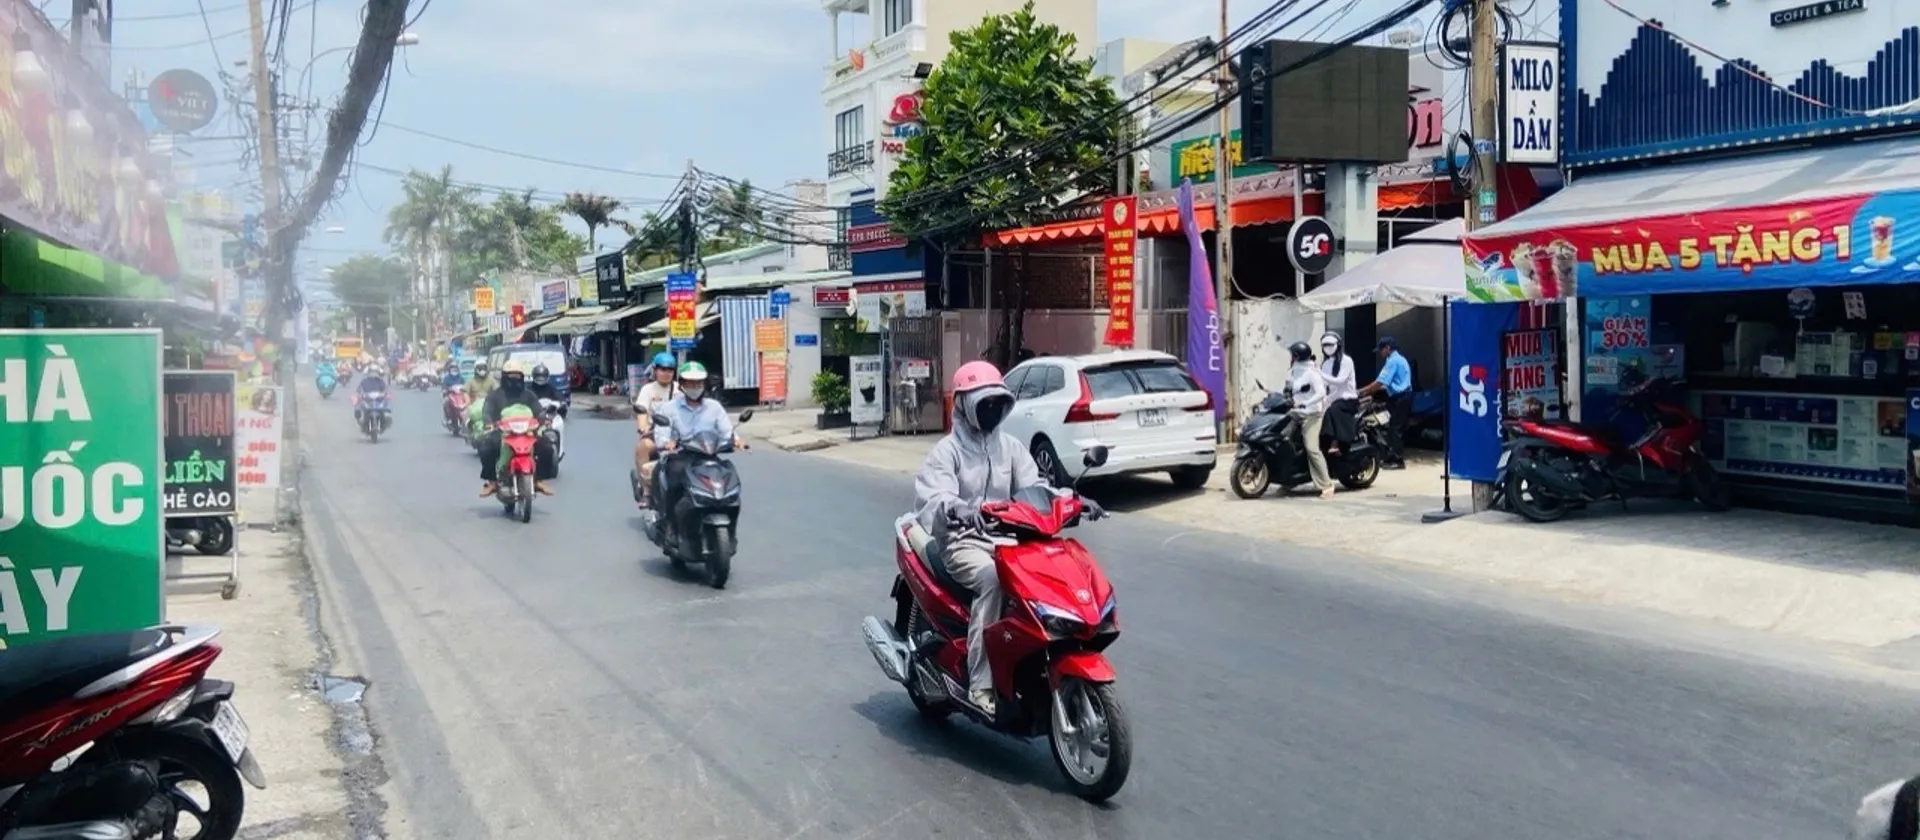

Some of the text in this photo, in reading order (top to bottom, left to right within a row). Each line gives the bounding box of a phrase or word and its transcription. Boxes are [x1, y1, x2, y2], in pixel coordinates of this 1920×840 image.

[1774, 0, 1859, 23] COFFEE & TEA
[1511, 58, 1553, 91] MILO
[1512, 100, 1552, 150] DẦM
[1300, 233, 1330, 260] 5G
[1592, 223, 1852, 275] MUA 5 TẶNG 1
[1604, 313, 1647, 331] GIẢM
[1504, 332, 1541, 357] MUA
[1603, 331, 1649, 348] 30%
[1459, 365, 1488, 418] 5G
[193, 488, 231, 508] CÀO
